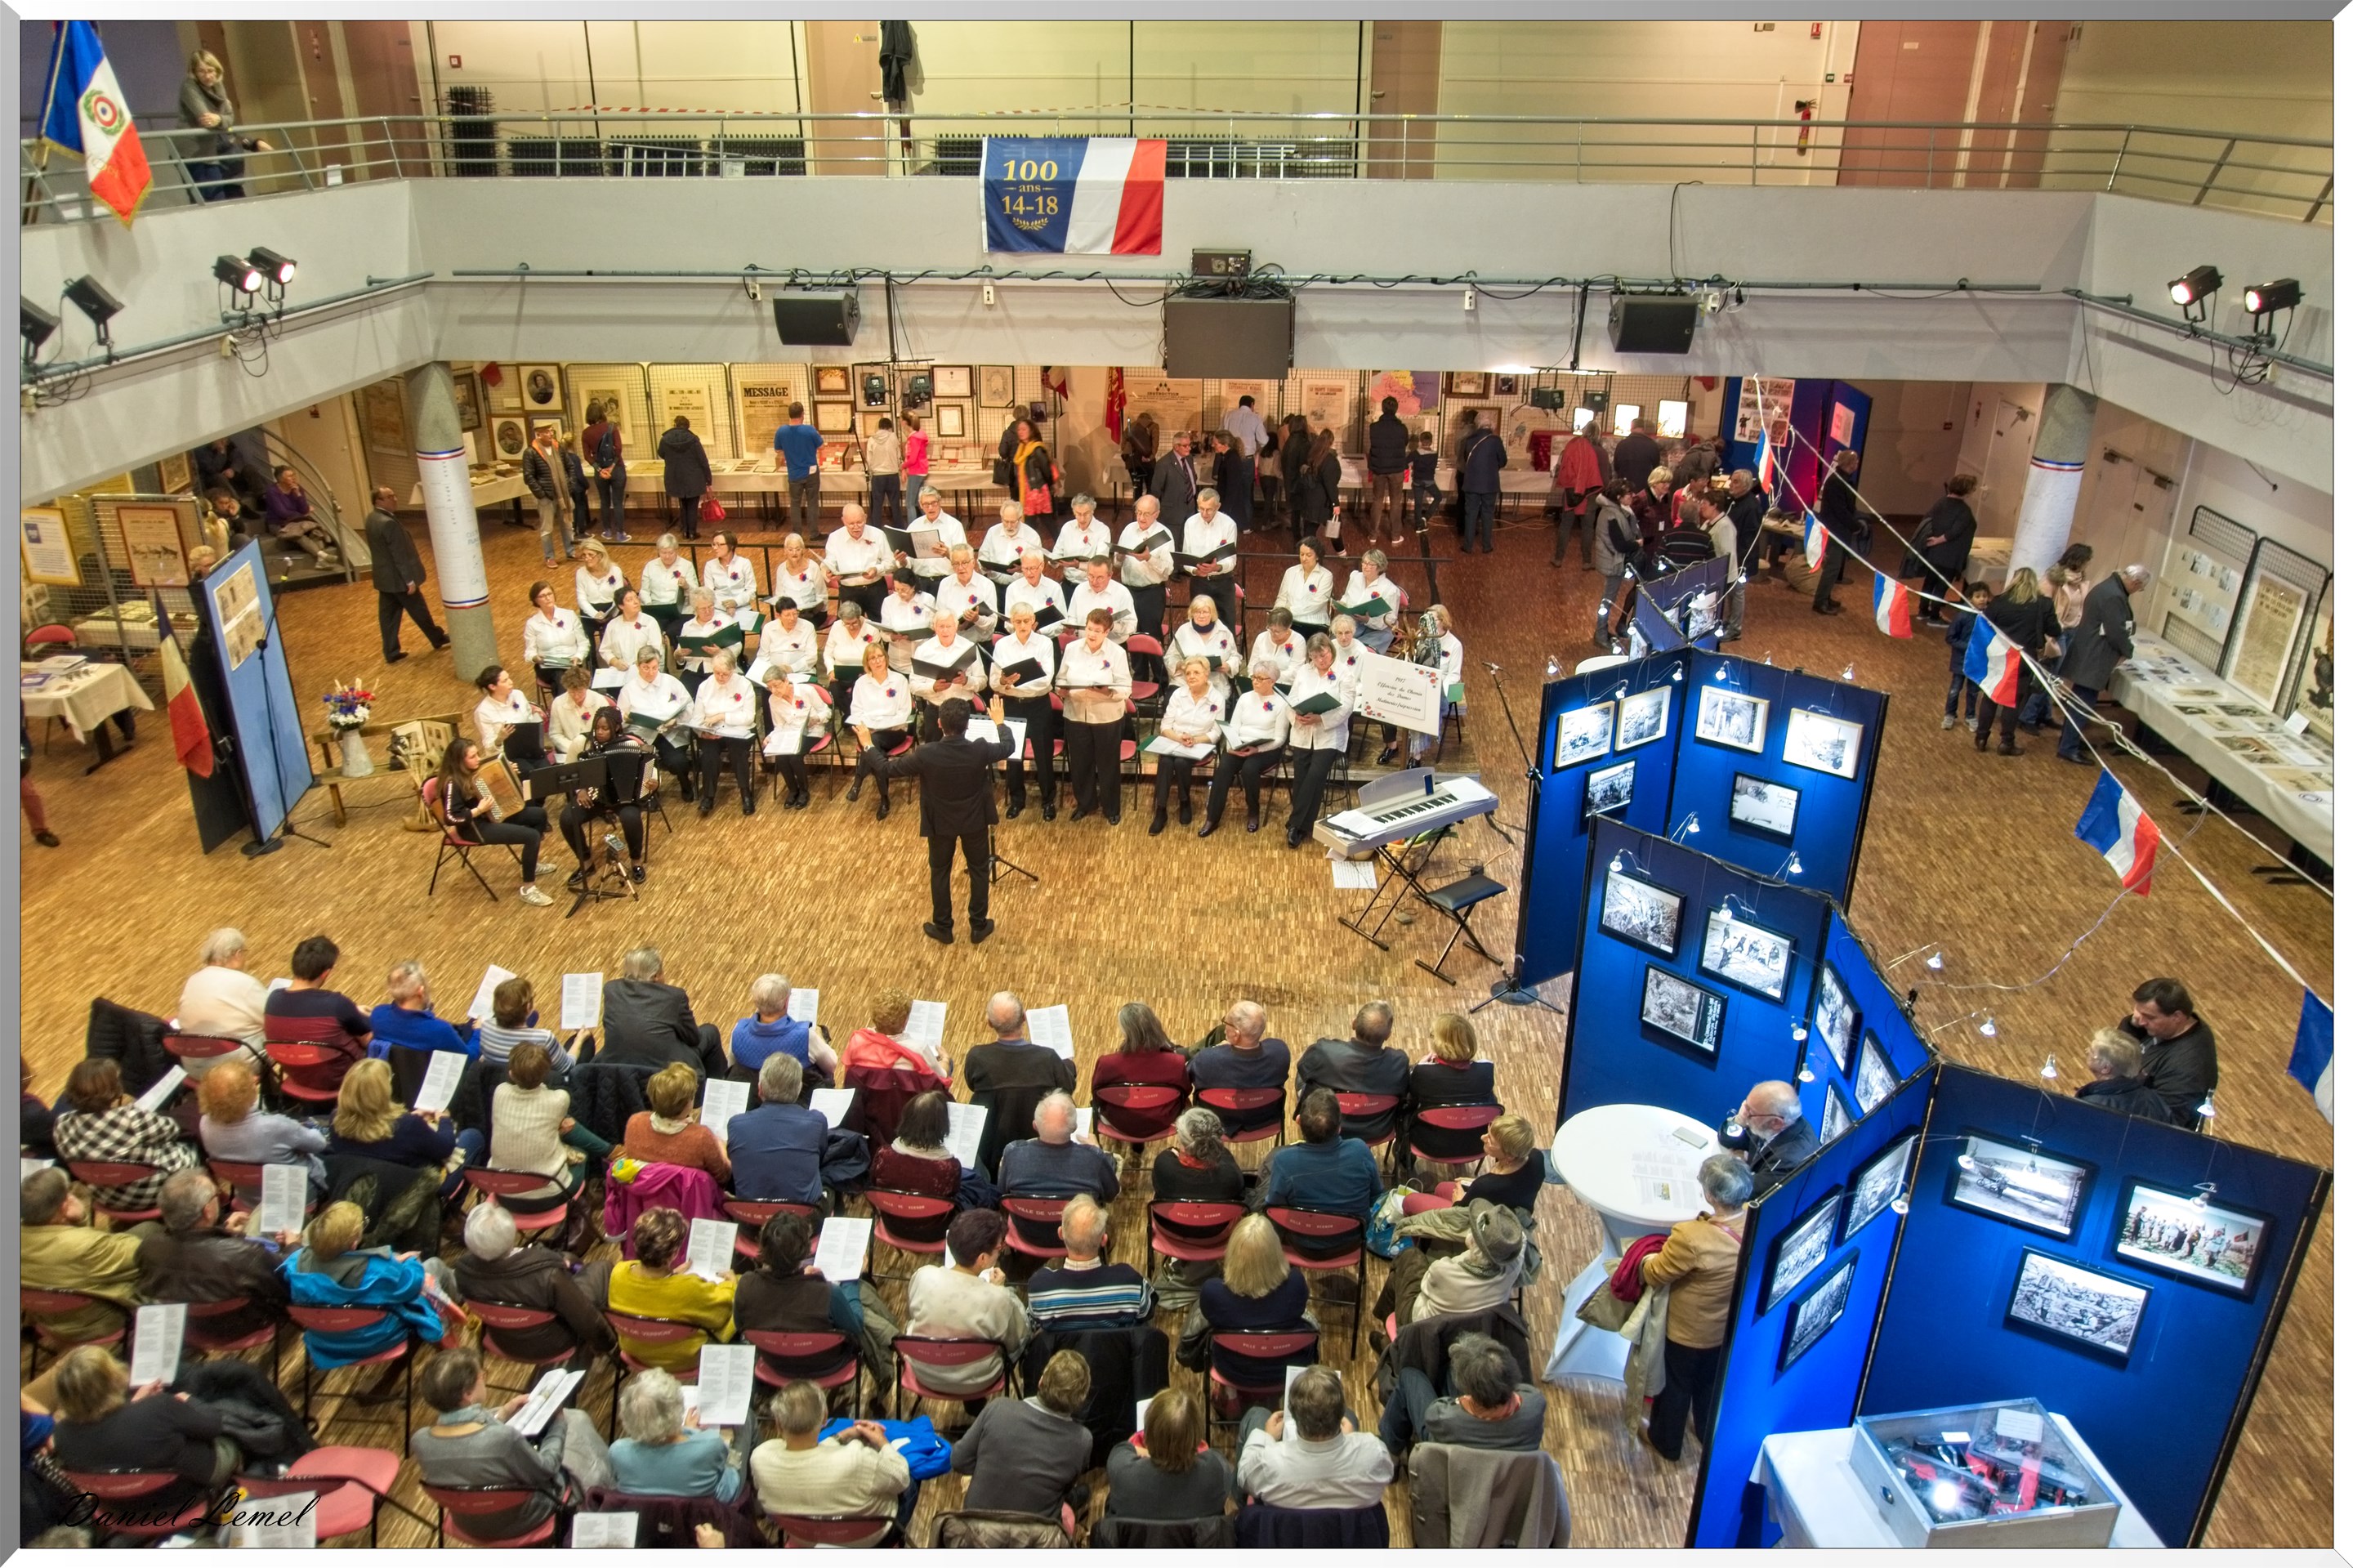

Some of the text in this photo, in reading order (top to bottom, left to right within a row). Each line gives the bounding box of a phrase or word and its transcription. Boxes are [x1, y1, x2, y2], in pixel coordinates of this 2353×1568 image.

[1003, 160, 1059, 181] 100
[1018, 184, 1041, 193] ans
[1002, 196, 1059, 215] 14-18
[743, 387, 788, 397] MESSAGE
